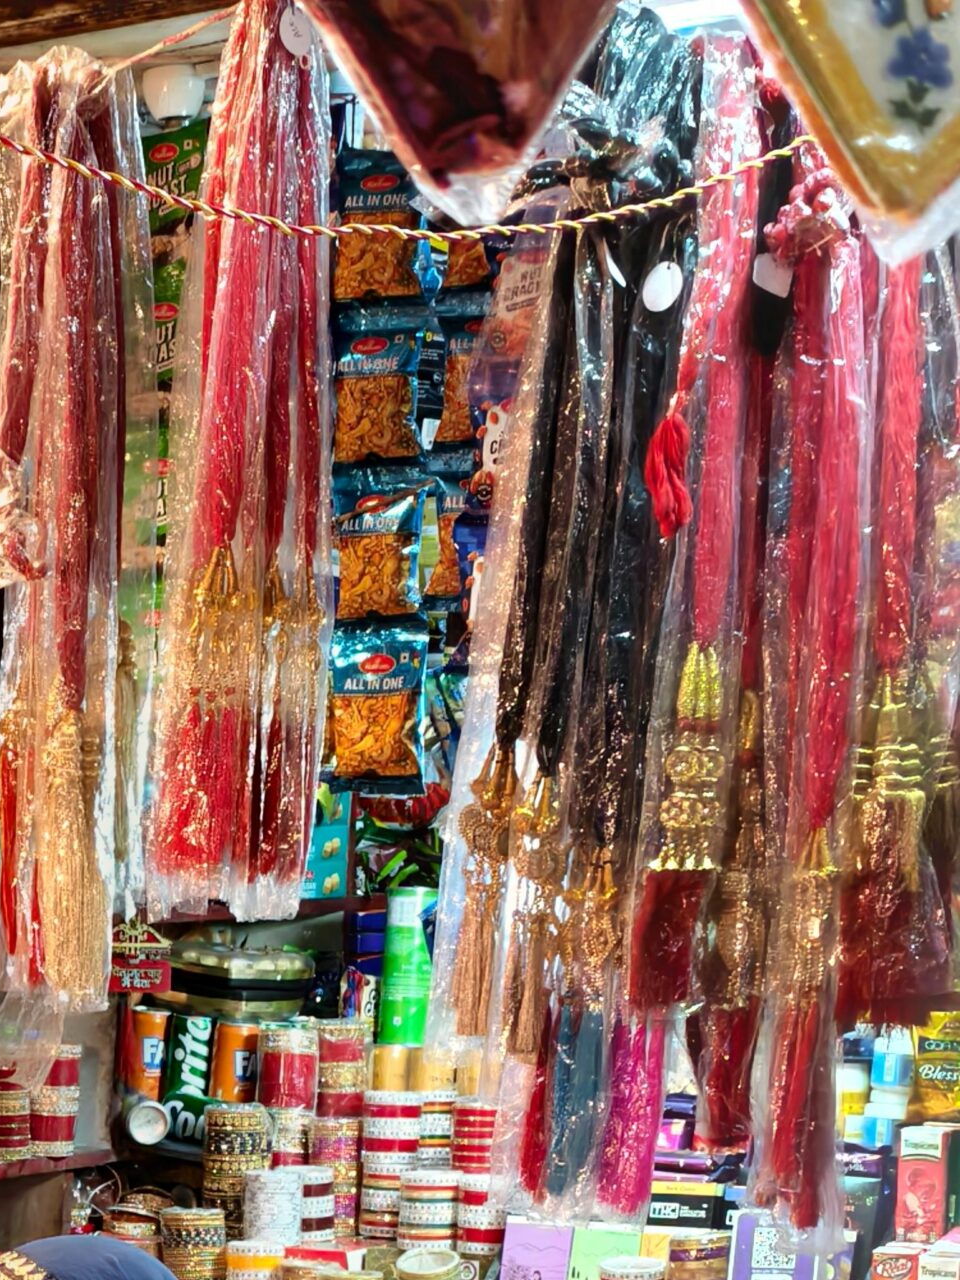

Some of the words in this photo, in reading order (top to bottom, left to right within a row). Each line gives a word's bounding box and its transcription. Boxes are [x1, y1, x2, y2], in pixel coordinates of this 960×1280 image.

[345, 195, 364, 208] ALL
[367, 195, 381, 206] IN
[383, 193, 409, 206] ONE
[155, 323, 175, 342] UT
[443, 496, 465, 509] ALL
[341, 519, 361, 532] ALL
[344, 677, 367, 691] ALL
[368, 676, 381, 689] IN
[383, 675, 405, 689] ONE
[176, 1017, 212, 1099] prite
